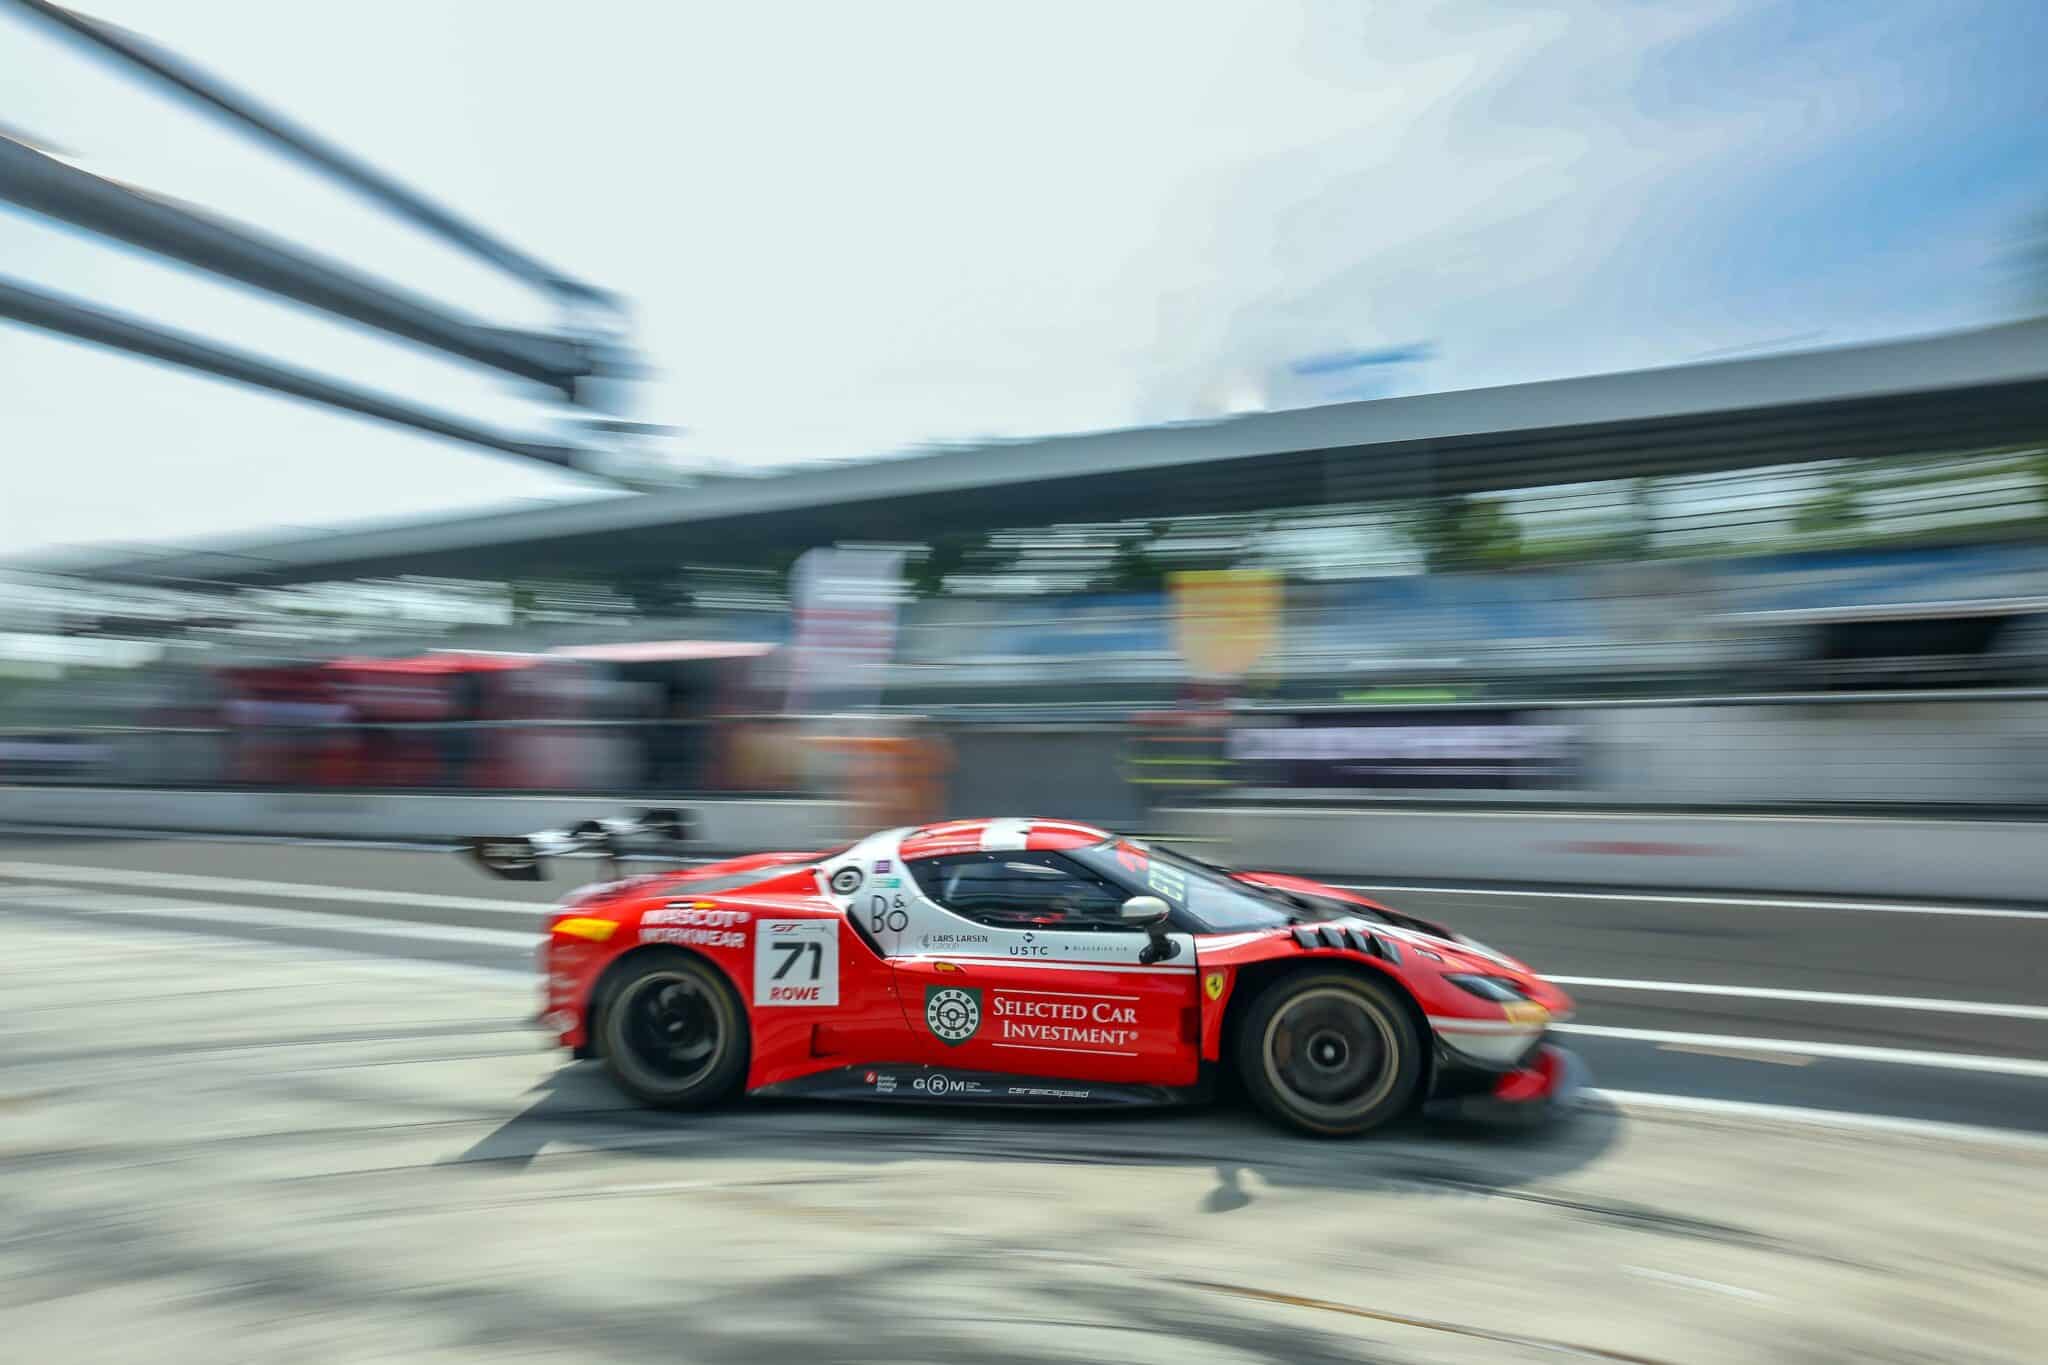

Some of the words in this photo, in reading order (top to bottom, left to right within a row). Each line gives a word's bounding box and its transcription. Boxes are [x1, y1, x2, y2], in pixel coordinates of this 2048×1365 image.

[932, 934, 955, 943] LARS
[956, 934, 989, 943] LARSEN
[1009, 945, 1049, 956] USTC
[771, 941, 823, 981] 71
[770, 986, 821, 1001] ROWE
